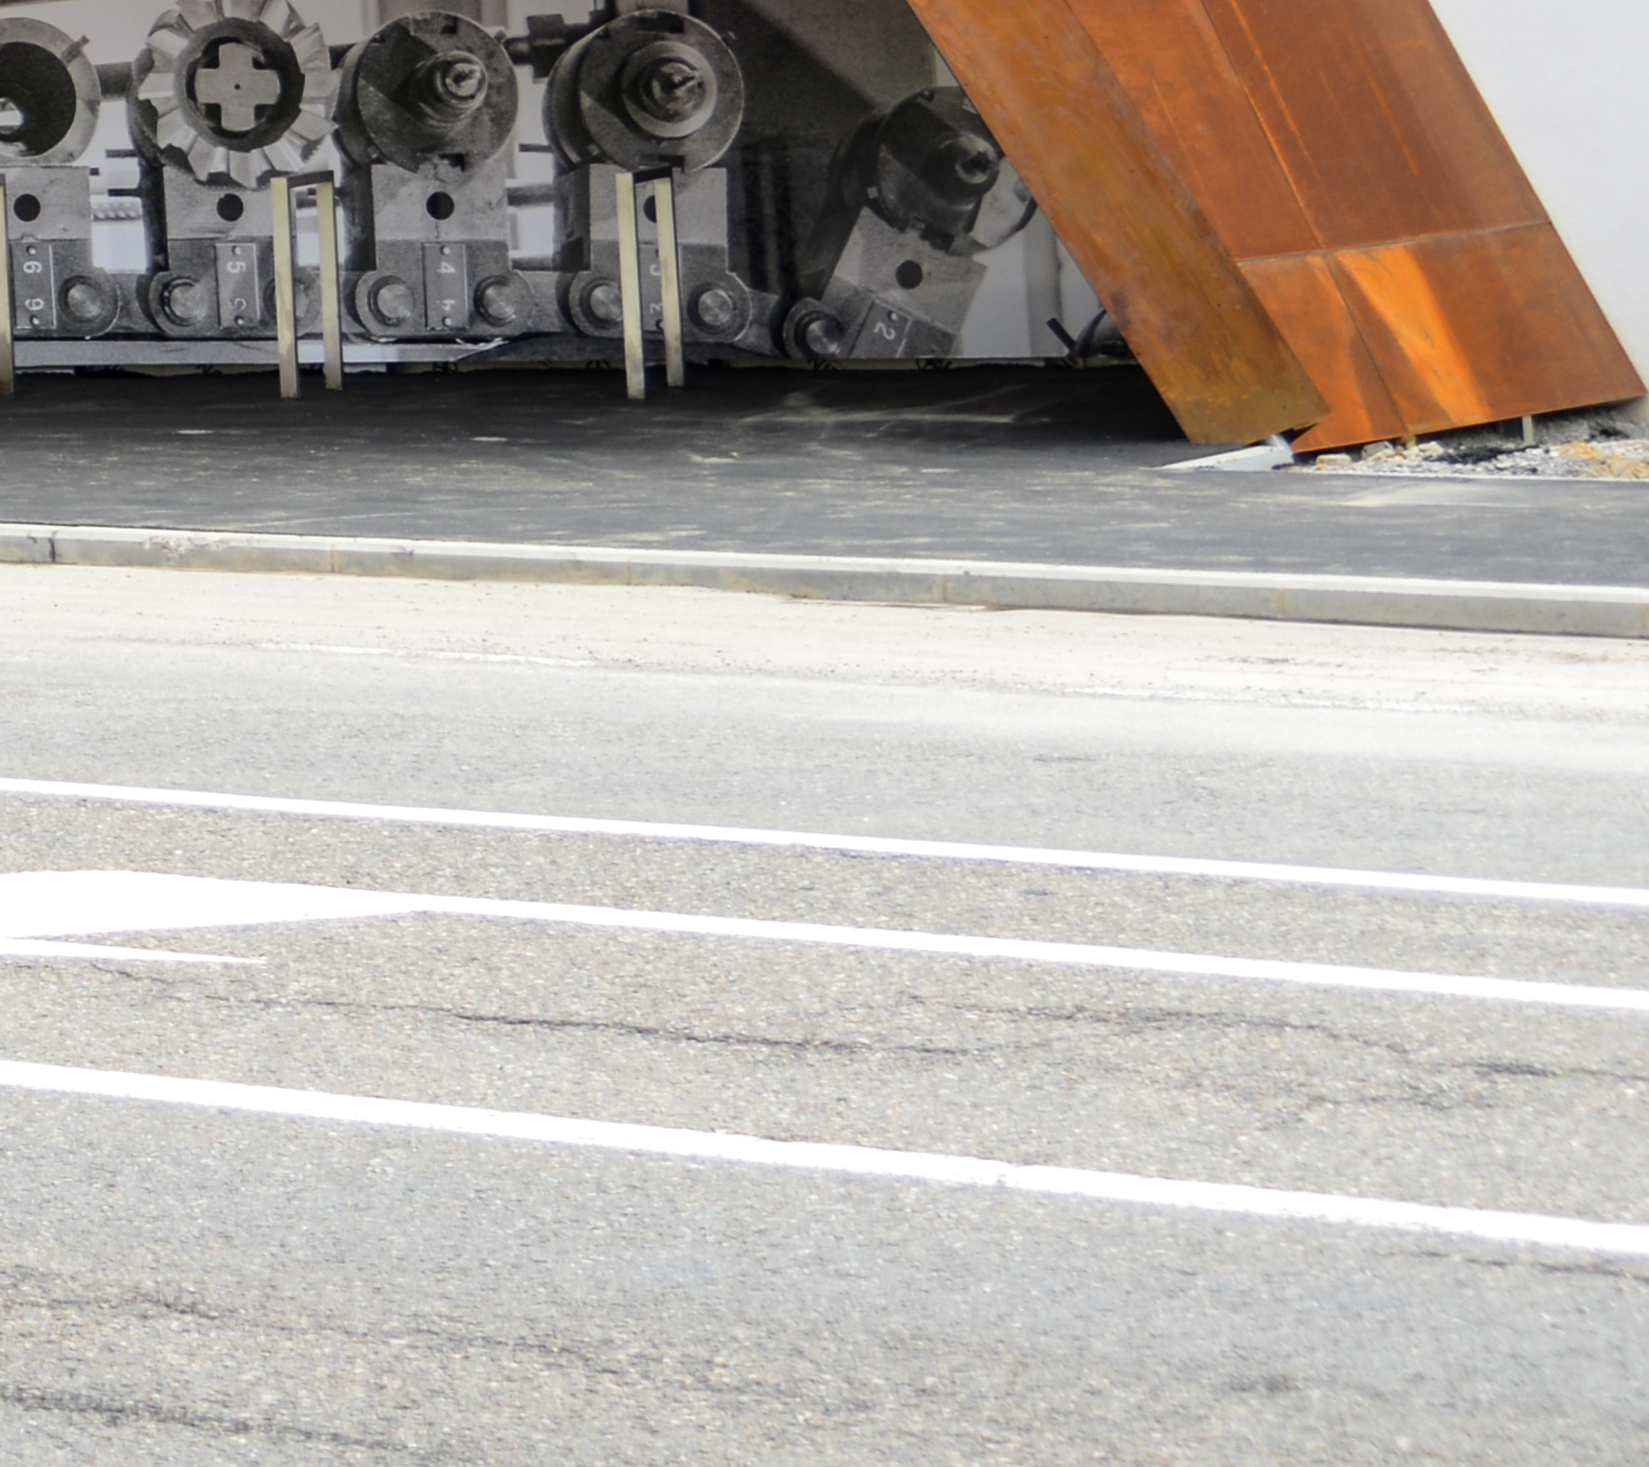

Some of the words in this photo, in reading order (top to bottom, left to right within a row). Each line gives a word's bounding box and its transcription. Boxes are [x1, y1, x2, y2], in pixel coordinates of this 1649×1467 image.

[226, 260, 245, 273] 5
[437, 261, 456, 274] 4
[874, 322, 896, 340] 2
